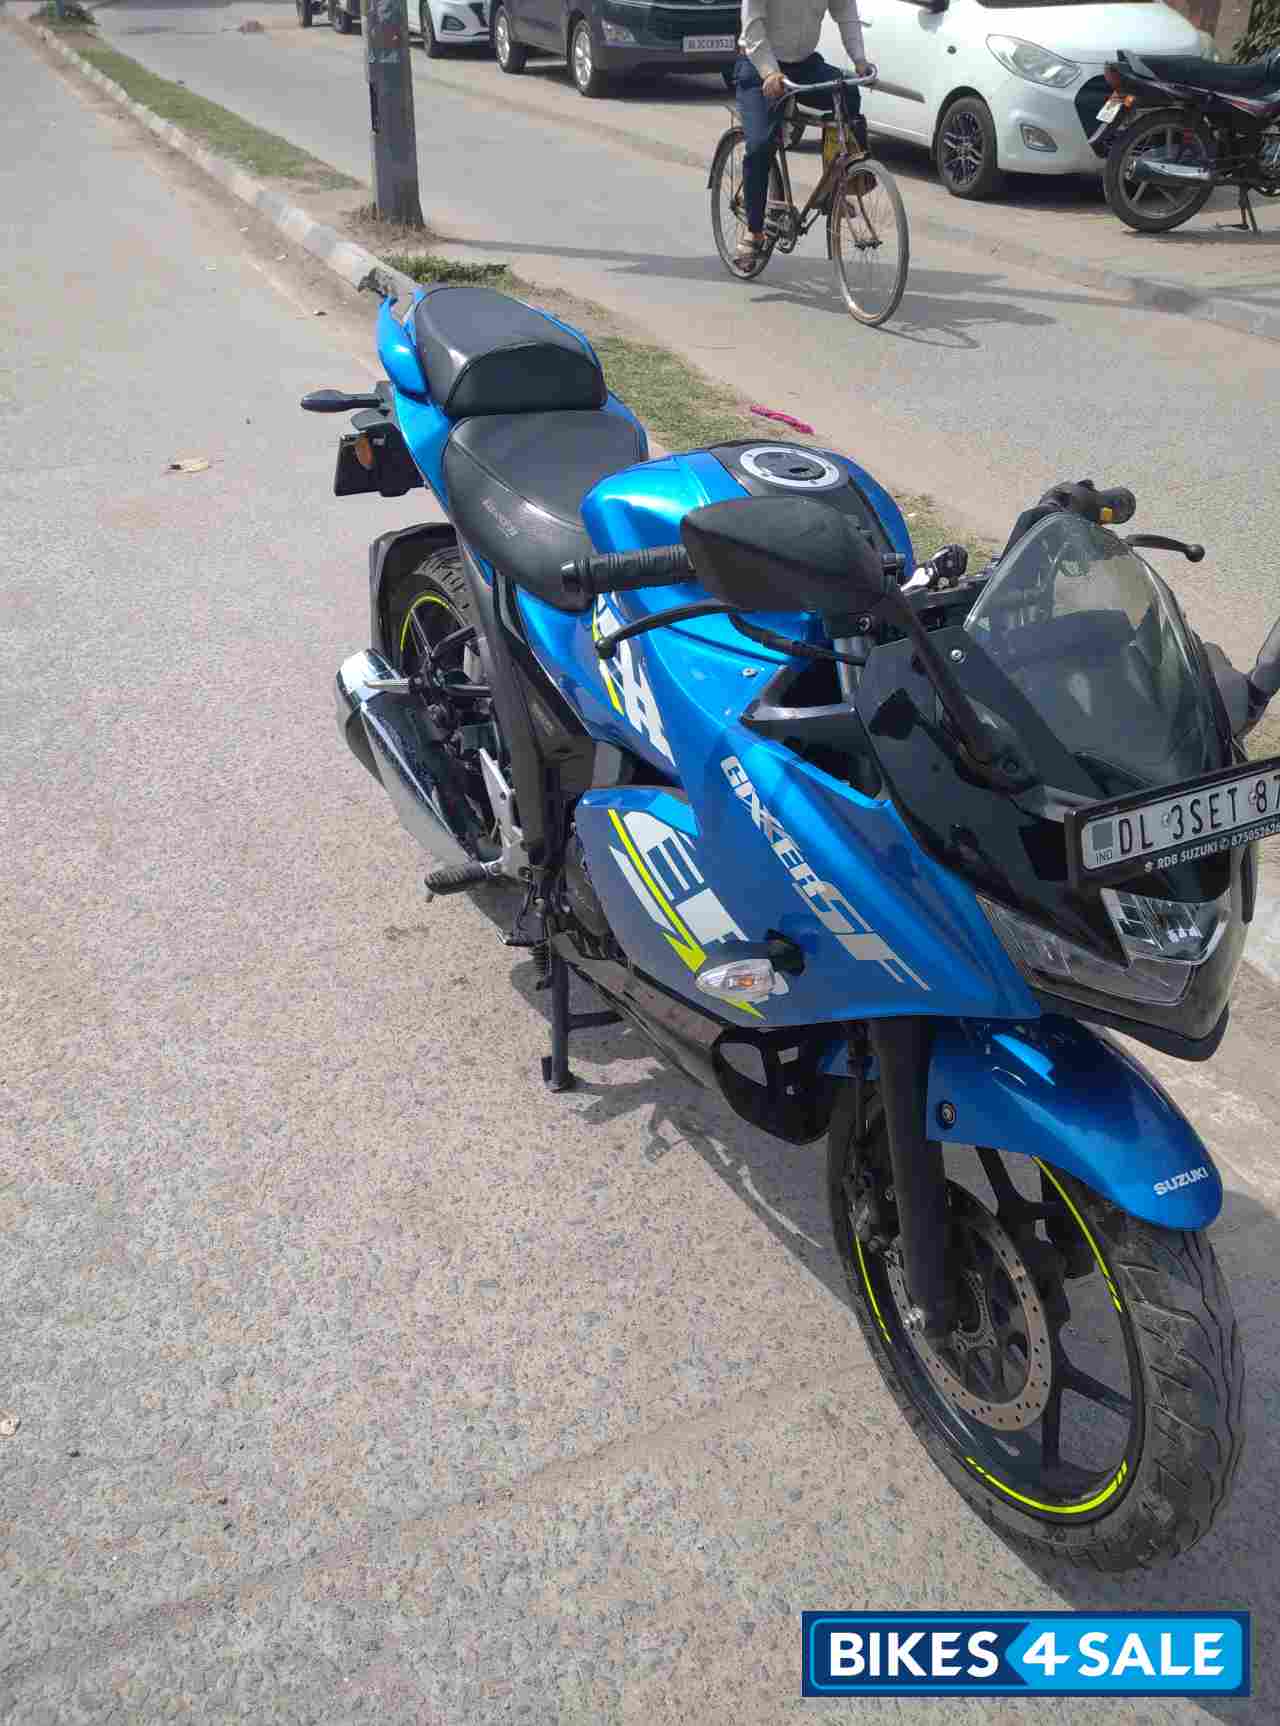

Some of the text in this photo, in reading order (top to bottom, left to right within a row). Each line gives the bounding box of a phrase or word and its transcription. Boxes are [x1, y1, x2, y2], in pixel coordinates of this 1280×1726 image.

[720, 756, 820, 897] GIXXER
[1119, 814, 1153, 855] DL
[1170, 787, 1238, 840] 3SET
[1095, 848, 1113, 865] IND
[1181, 841, 1218, 863] SUZUKI
[1153, 1166, 1209, 1196] SUZUKI
